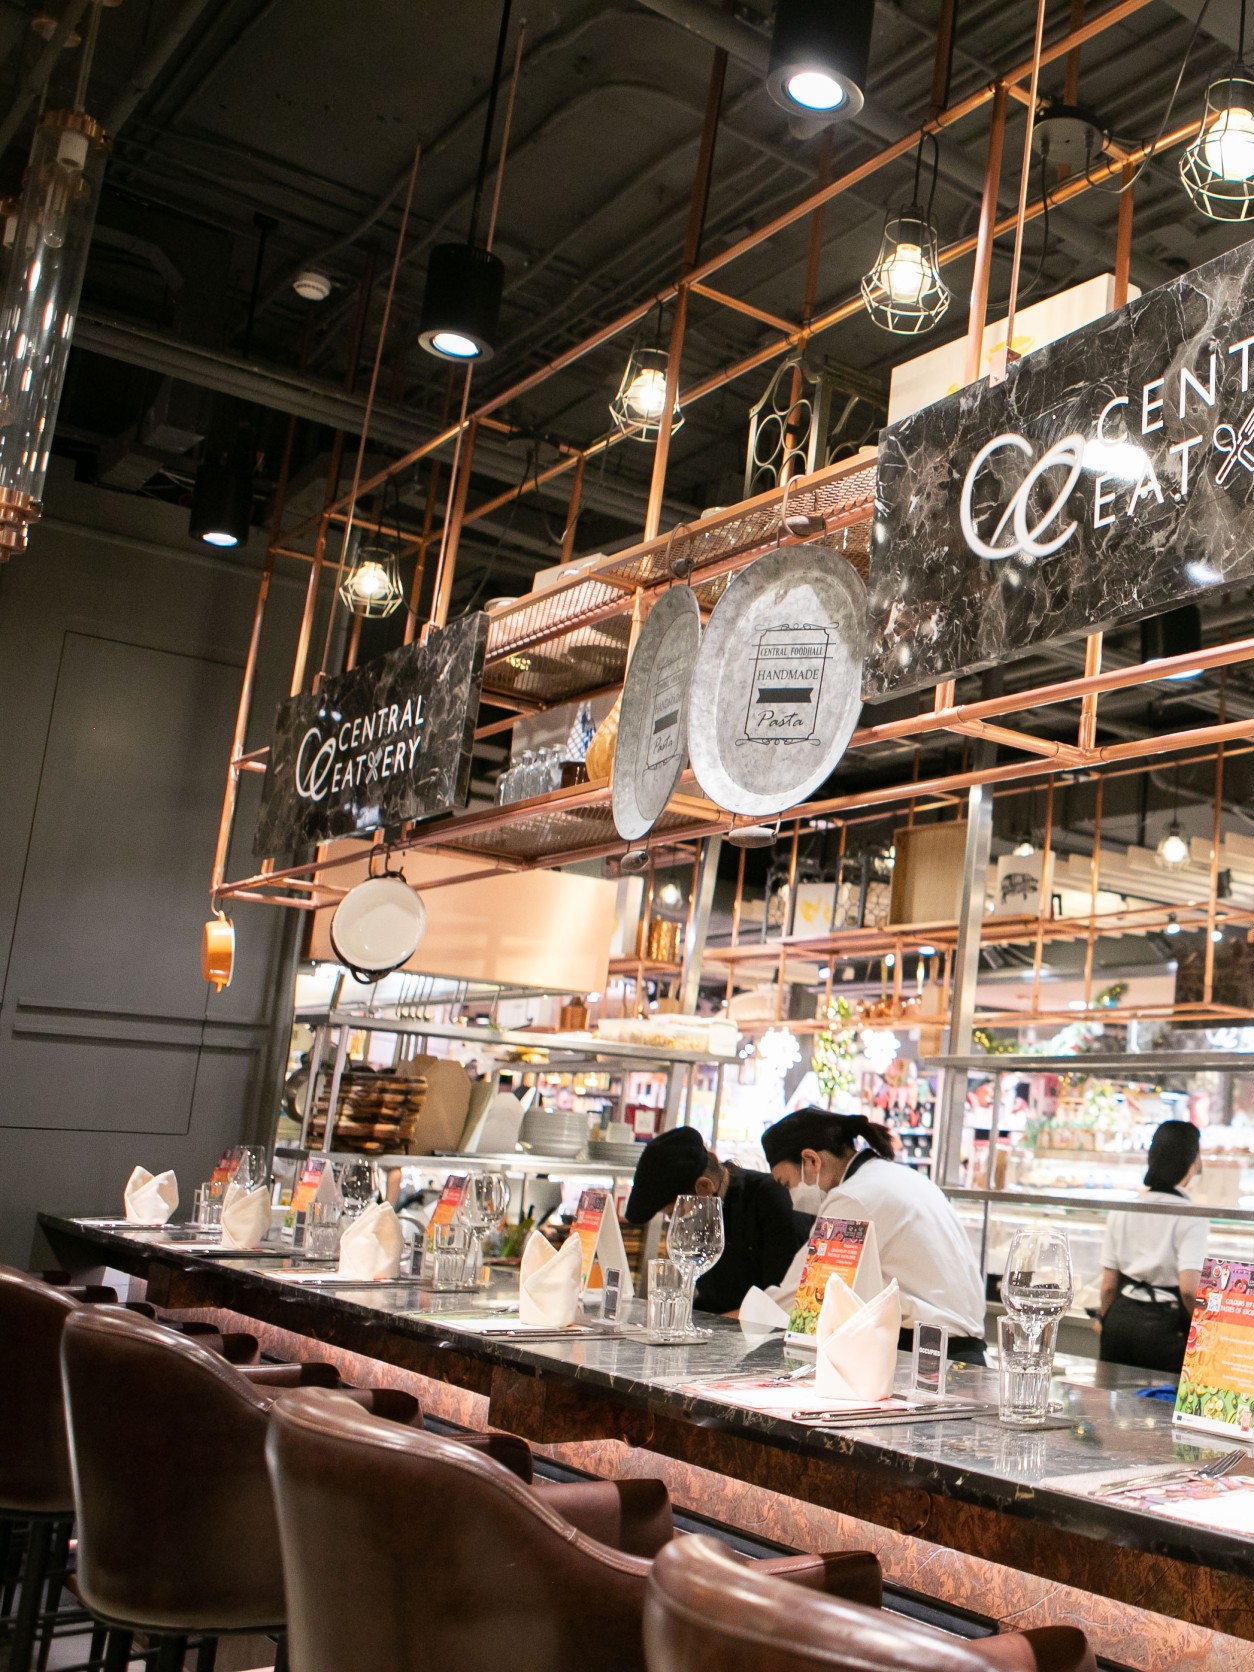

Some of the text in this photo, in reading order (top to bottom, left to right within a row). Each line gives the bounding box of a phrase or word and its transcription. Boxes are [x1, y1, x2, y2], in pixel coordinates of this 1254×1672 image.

[760, 646, 823, 657] CENTRAL FOODHALL
[757, 668, 819, 681] HANDMADE
[339, 694, 425, 751] CENTRAL
[757, 709, 804, 728] Pasta
[919, 1347, 941, 1357] OCCUPIED
